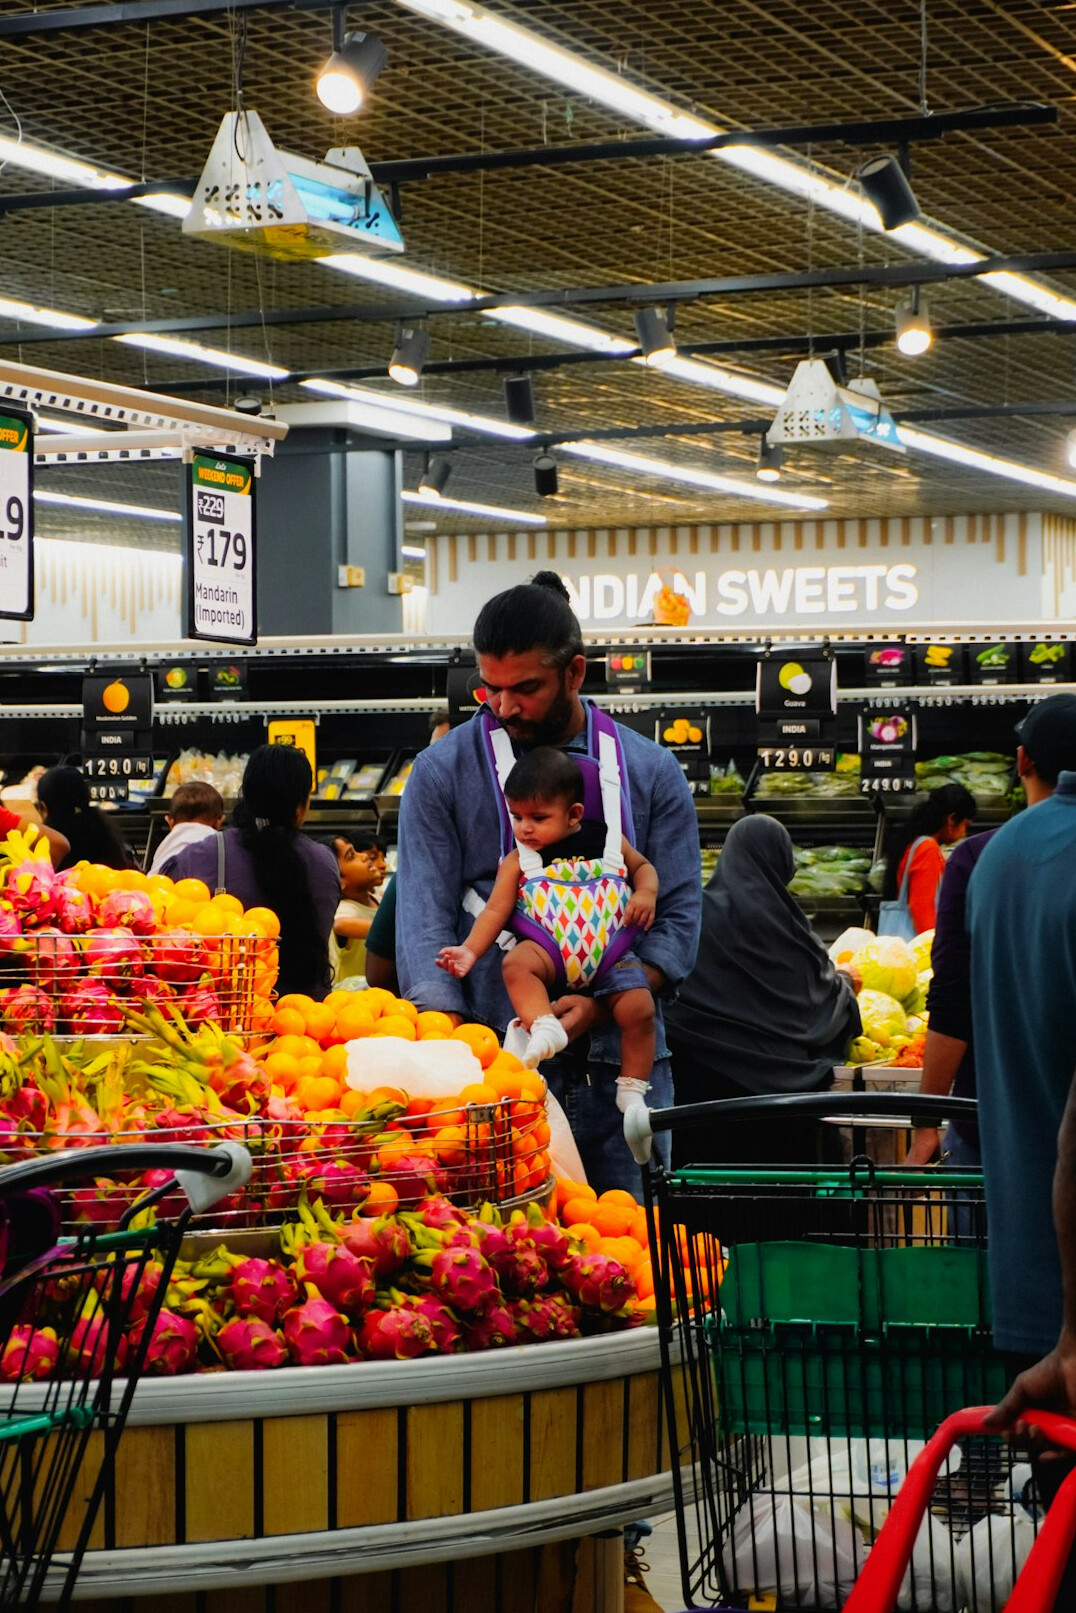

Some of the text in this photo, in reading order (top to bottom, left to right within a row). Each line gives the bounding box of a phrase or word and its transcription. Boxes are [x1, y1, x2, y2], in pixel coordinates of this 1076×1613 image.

[198, 467, 245, 488] WEEKEND OFFER
[197, 528, 247, 571] ₹179
[195, 582, 238, 604] Mandarin
[561, 563, 919, 619] NDIAN SWEETS
[195, 604, 245, 630] (Imported)
[784, 699, 806, 708] Guava
[101, 735, 122, 744] INDIA
[782, 725, 807, 734] INDIA
